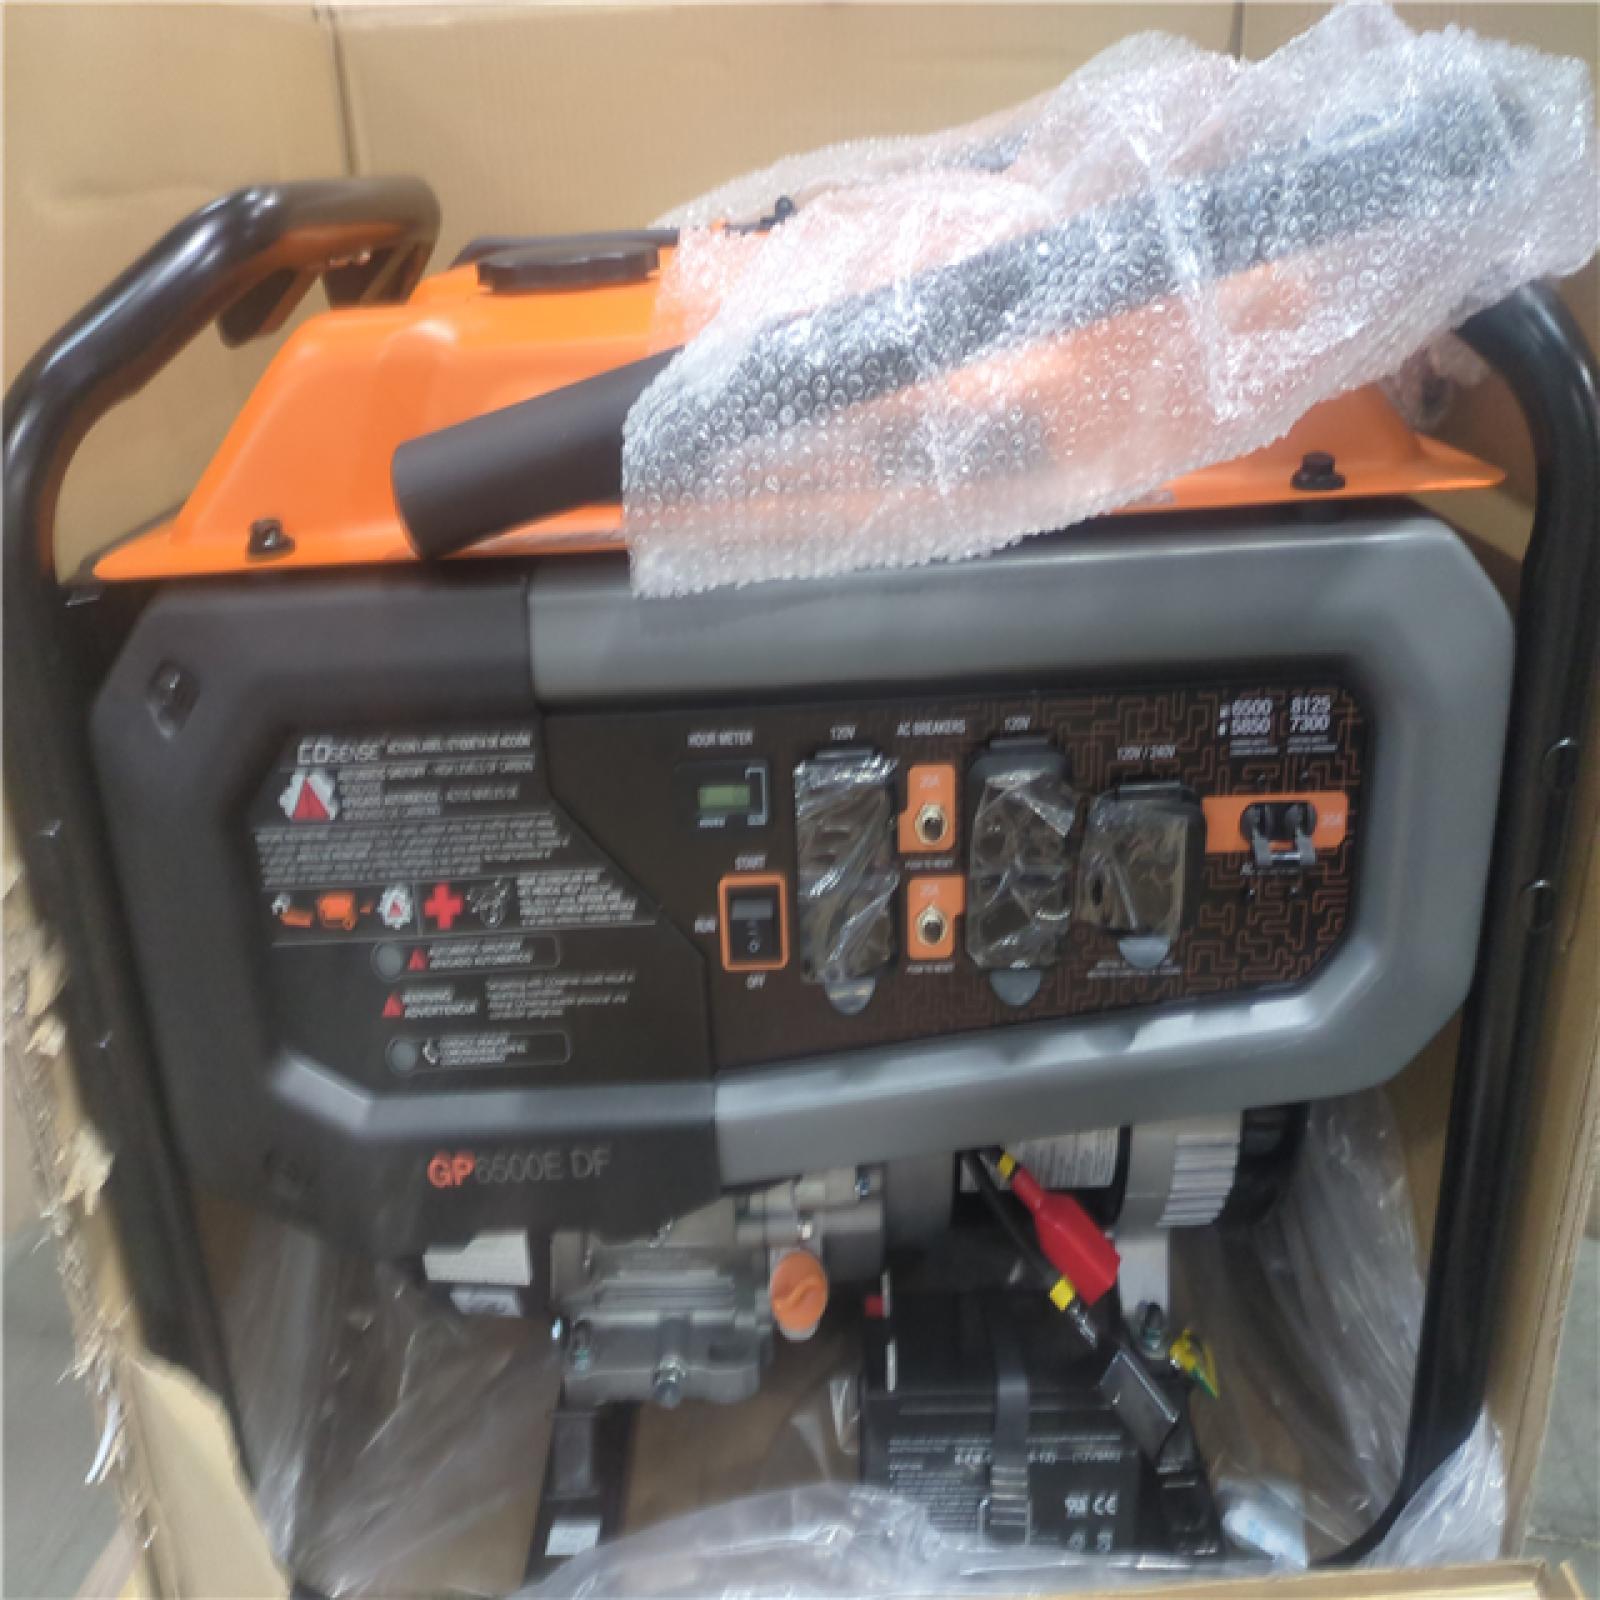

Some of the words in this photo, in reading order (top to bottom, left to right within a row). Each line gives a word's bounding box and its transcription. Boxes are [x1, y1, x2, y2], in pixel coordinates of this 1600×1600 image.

[1231, 698, 1273, 716] 6500
[1290, 695, 1332, 715] 8125
[829, 724, 857, 741] 120V
[896, 721, 911, 737] AC
[913, 718, 966, 736] BREAKERS
[1230, 717, 1271, 736] 5850
[1290, 715, 1331, 733] 7300
[688, 731, 717, 748] HOUR
[719, 729, 754, 747] METER
[735, 854, 767, 871] START
[746, 973, 767, 990] OFF
[570, 1147, 611, 1181] DF
